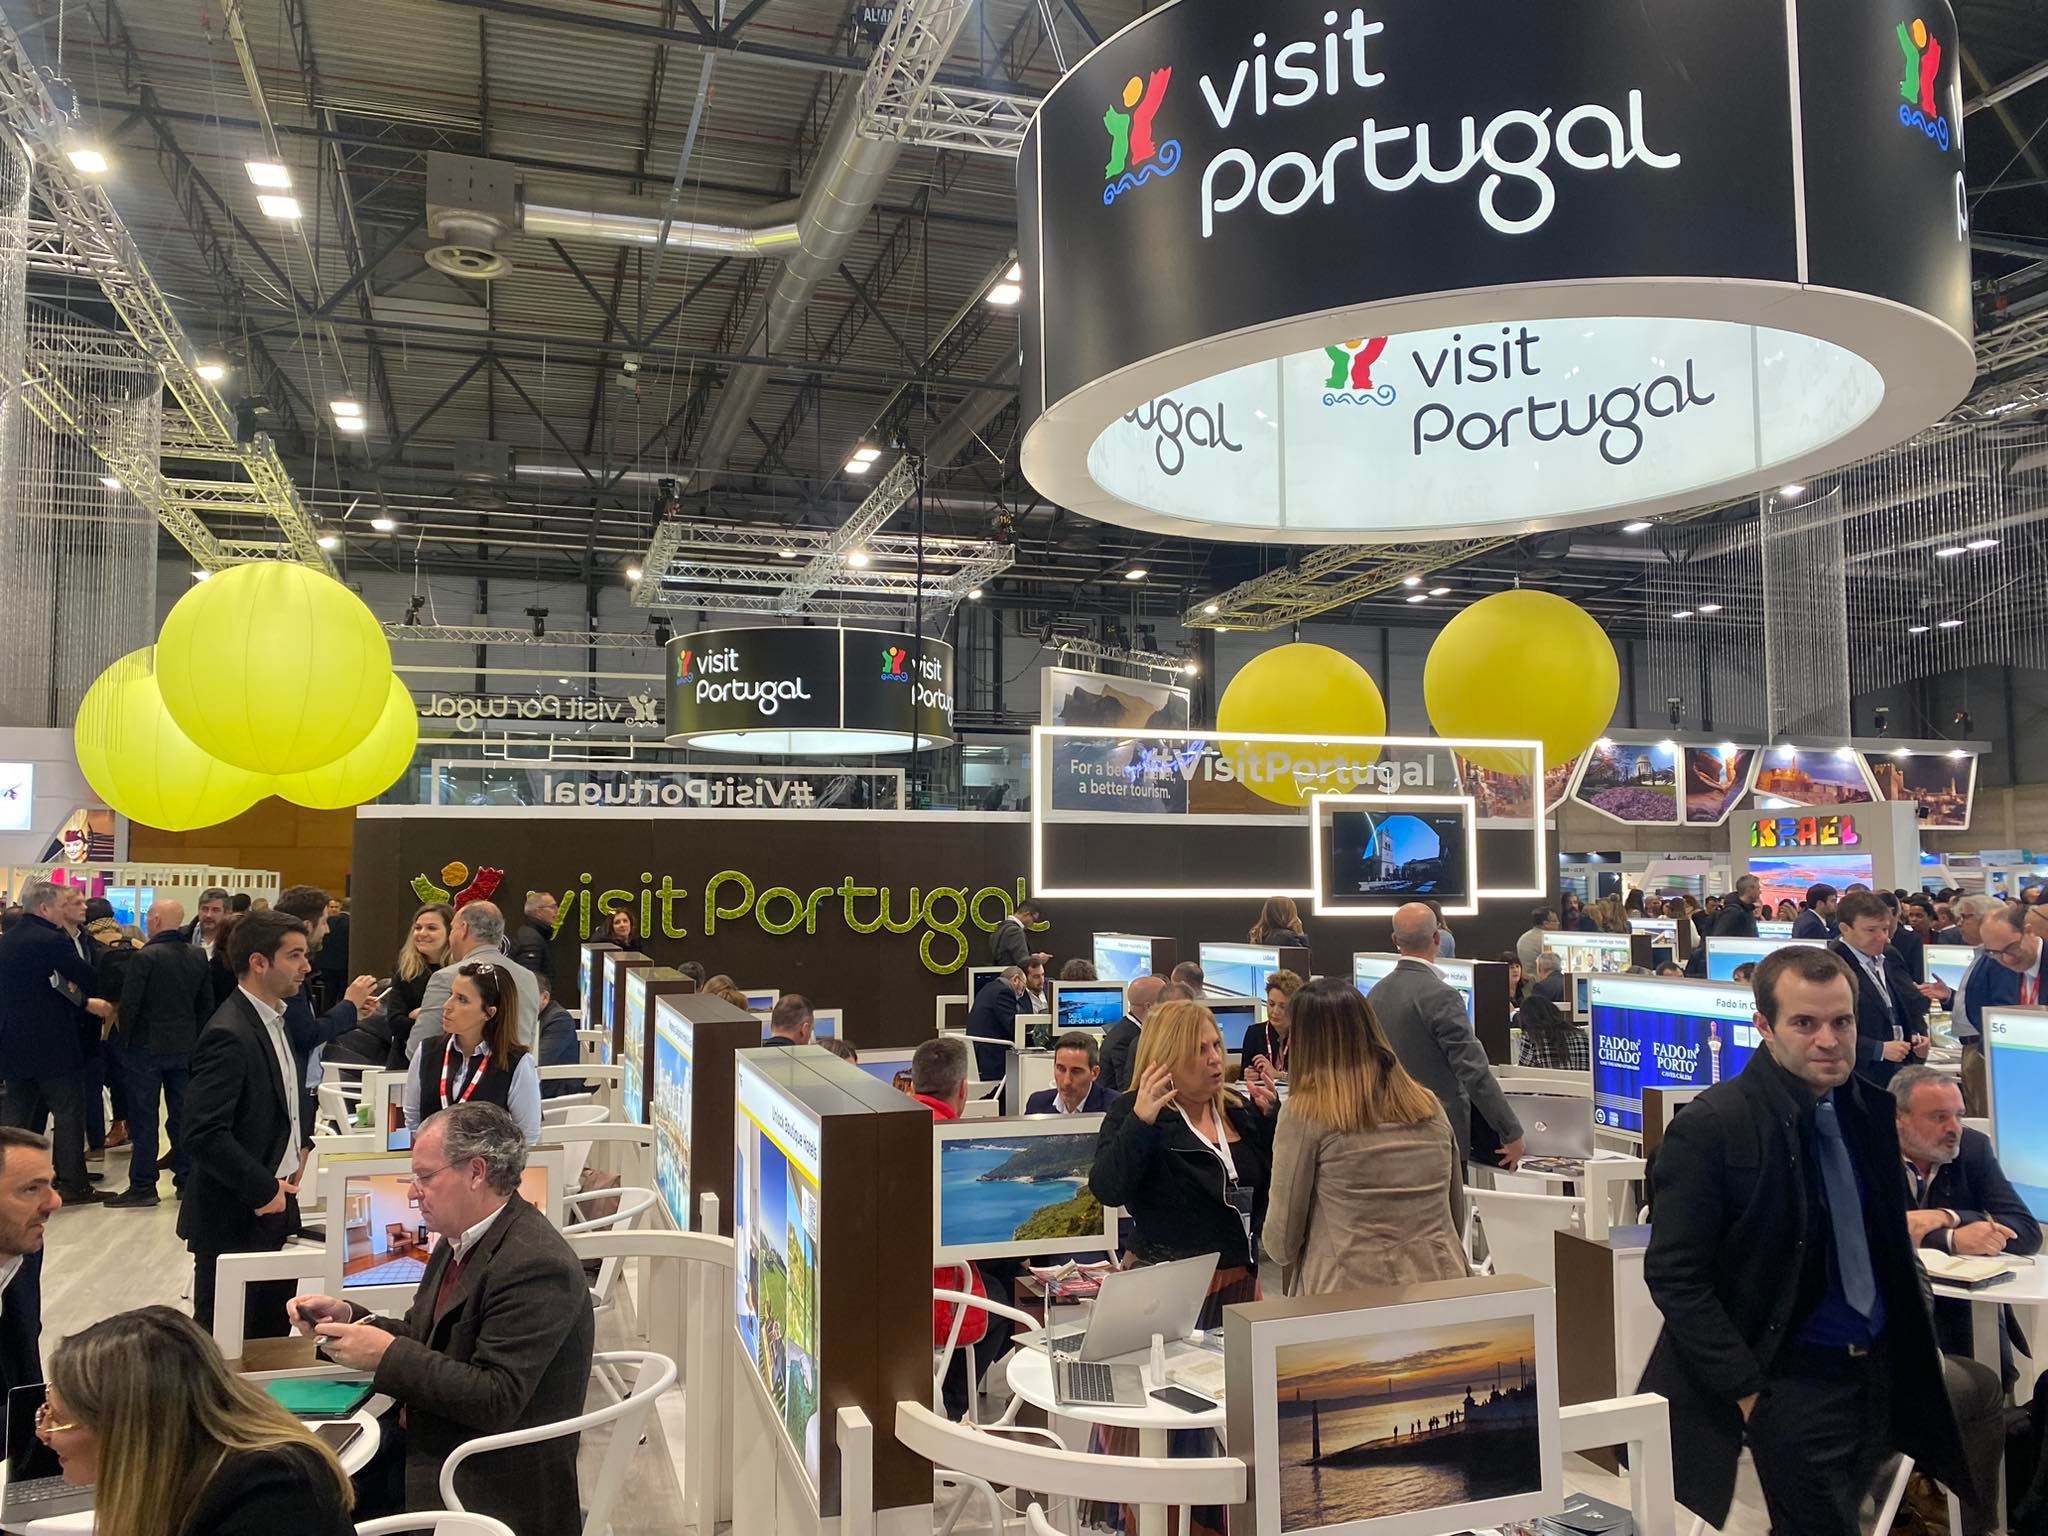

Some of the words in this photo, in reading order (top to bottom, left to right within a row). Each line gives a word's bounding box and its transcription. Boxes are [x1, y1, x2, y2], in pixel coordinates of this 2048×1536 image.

[1199, 8, 1385, 128] visit
[1412, 326, 1541, 388] visit
[696, 648, 739, 674] visit
[1070, 759, 1092, 775] For
[1096, 763, 1103, 775] a
[1106, 761, 1140, 779] betr
[1150, 746, 1434, 793] #VisitPortugal
[1079, 781, 1087, 794] a
[1090, 779, 1127, 796] better
[1130, 783, 1171, 799] tourism.
[704, 870, 1050, 975] Portugal
[1716, 998, 1737, 1009] Fado
[1739, 999, 1748, 1009] in
[1992, 1022, 2007, 1034] 56
[1599, 1035, 1629, 1051] FADO
[1630, 1041, 1640, 1051] IN
[1653, 1042, 1687, 1060] FADO
[1687, 1049, 1697, 1059] IN
